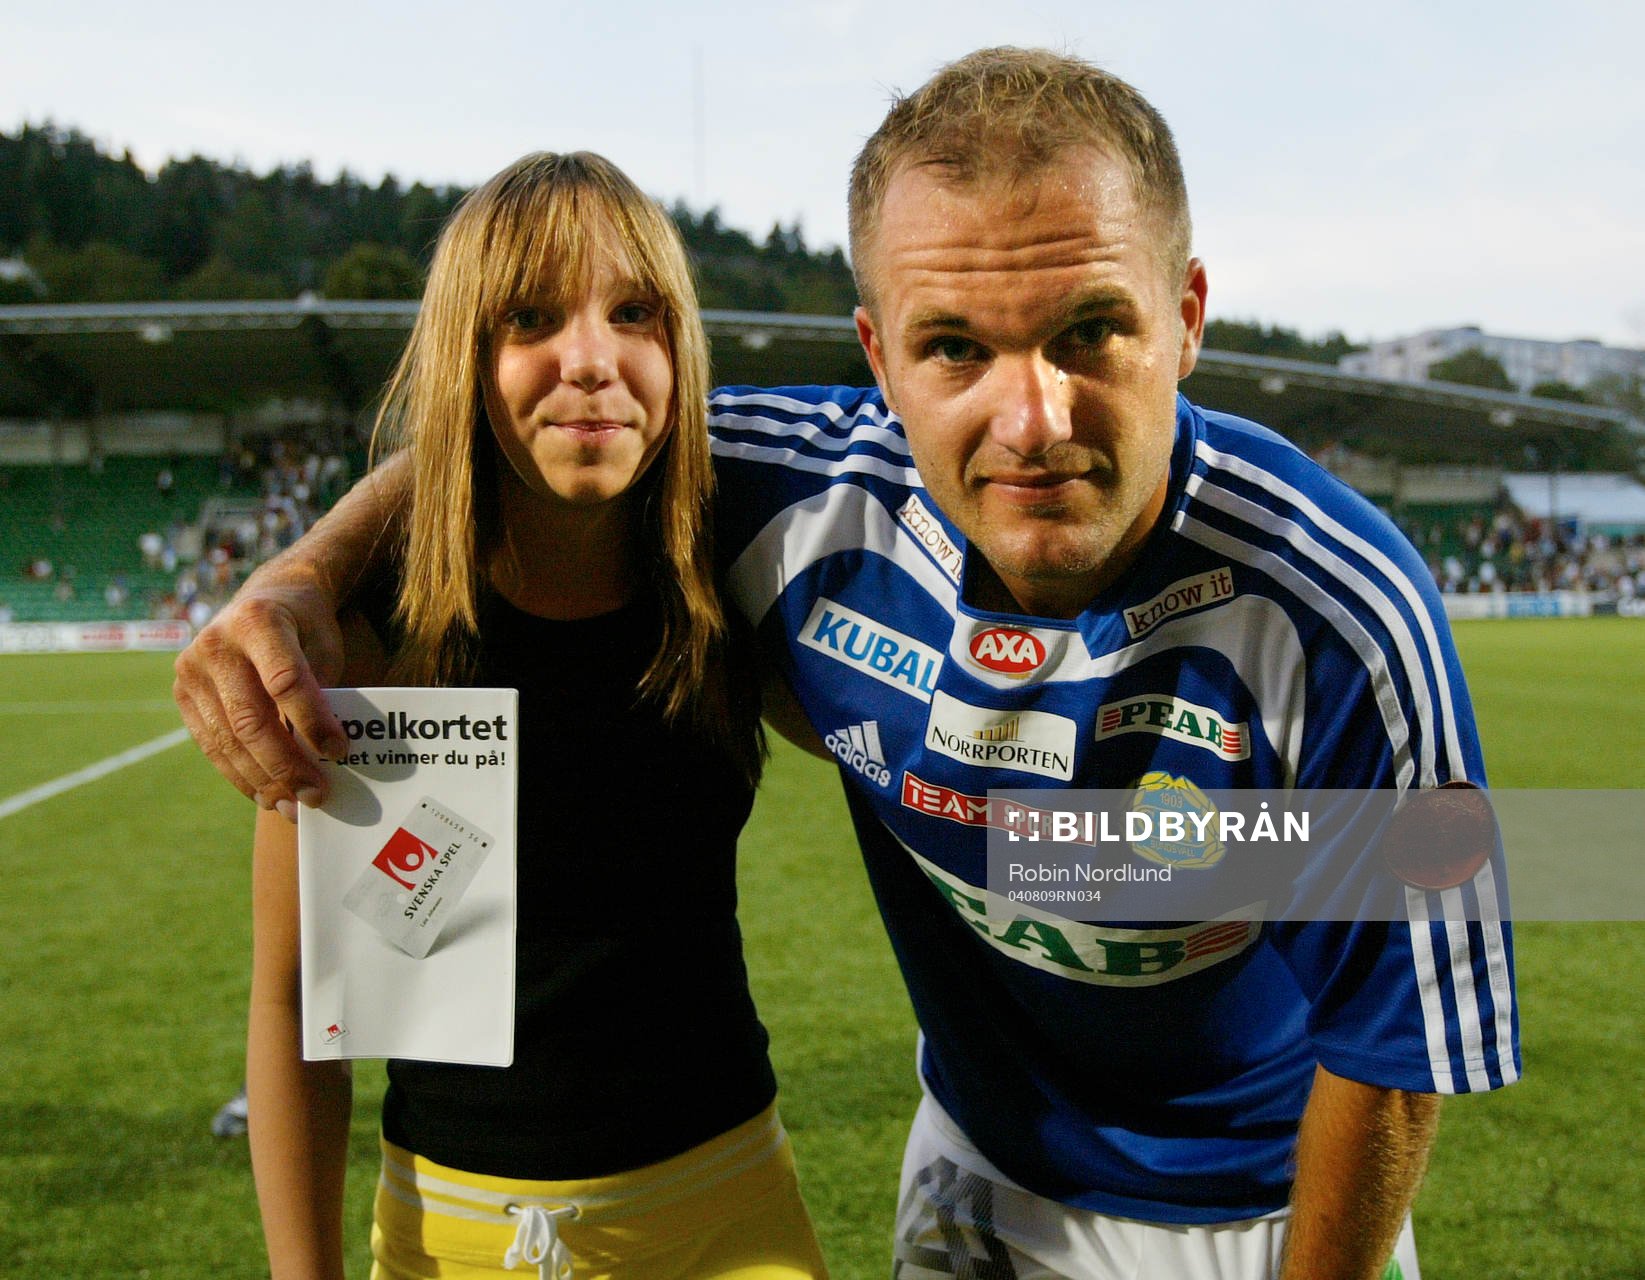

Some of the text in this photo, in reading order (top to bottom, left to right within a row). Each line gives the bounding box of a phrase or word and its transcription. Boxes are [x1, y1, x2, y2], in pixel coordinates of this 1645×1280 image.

[900, 499, 953, 560] know
[1126, 572, 1232, 635] know it
[812, 610, 936, 696] KUBAL
[976, 633, 1038, 666] AXA
[333, 711, 508, 741] pelkortet
[1119, 701, 1222, 748] PEAB
[376, 750, 439, 765] vinner
[445, 750, 468, 765] du
[475, 750, 506, 769] på!
[824, 734, 892, 788] adidas
[932, 726, 1069, 773] NORRPORTEN
[909, 778, 992, 822] TEAM
[404, 868, 443, 919] SVENSKA
[440, 842, 462, 867] SPEL
